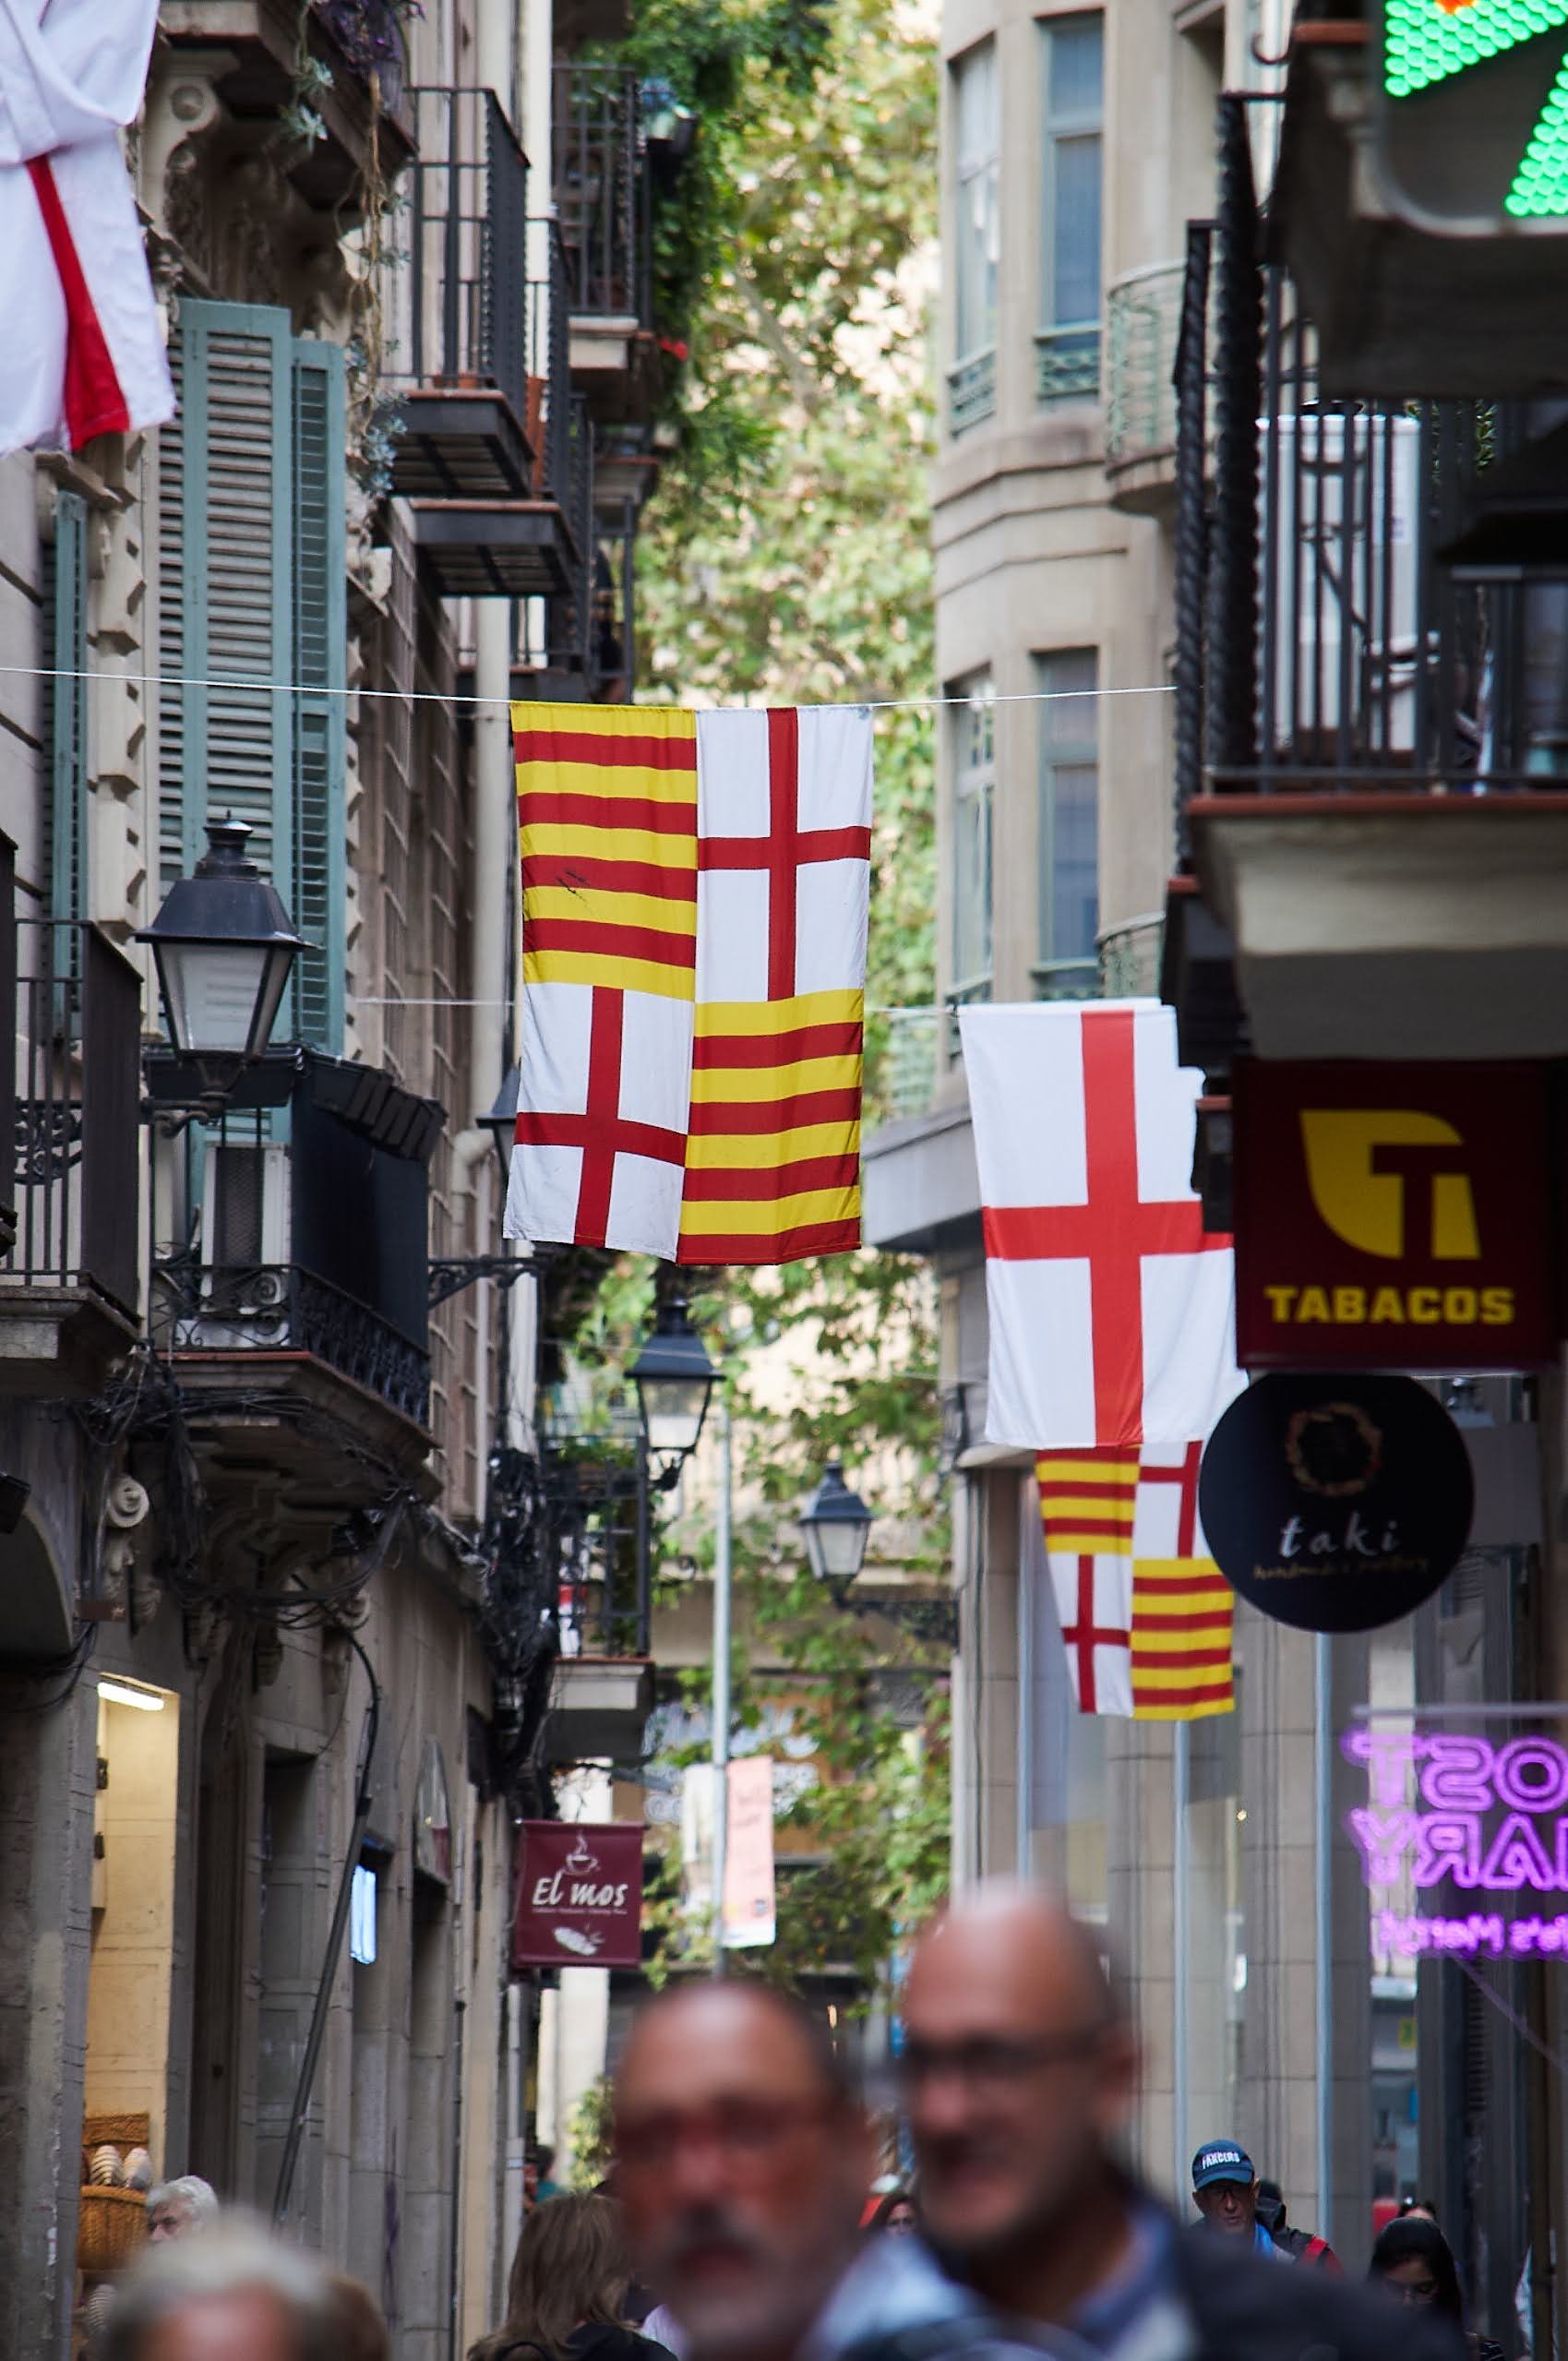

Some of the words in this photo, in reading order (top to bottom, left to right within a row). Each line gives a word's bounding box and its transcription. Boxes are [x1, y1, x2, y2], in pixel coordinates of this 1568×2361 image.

[1264, 1285, 1515, 1325] TABACOS
[1279, 1512, 1402, 1559] taki
[532, 1869, 565, 1906] El
[569, 1883, 628, 1907] mos
